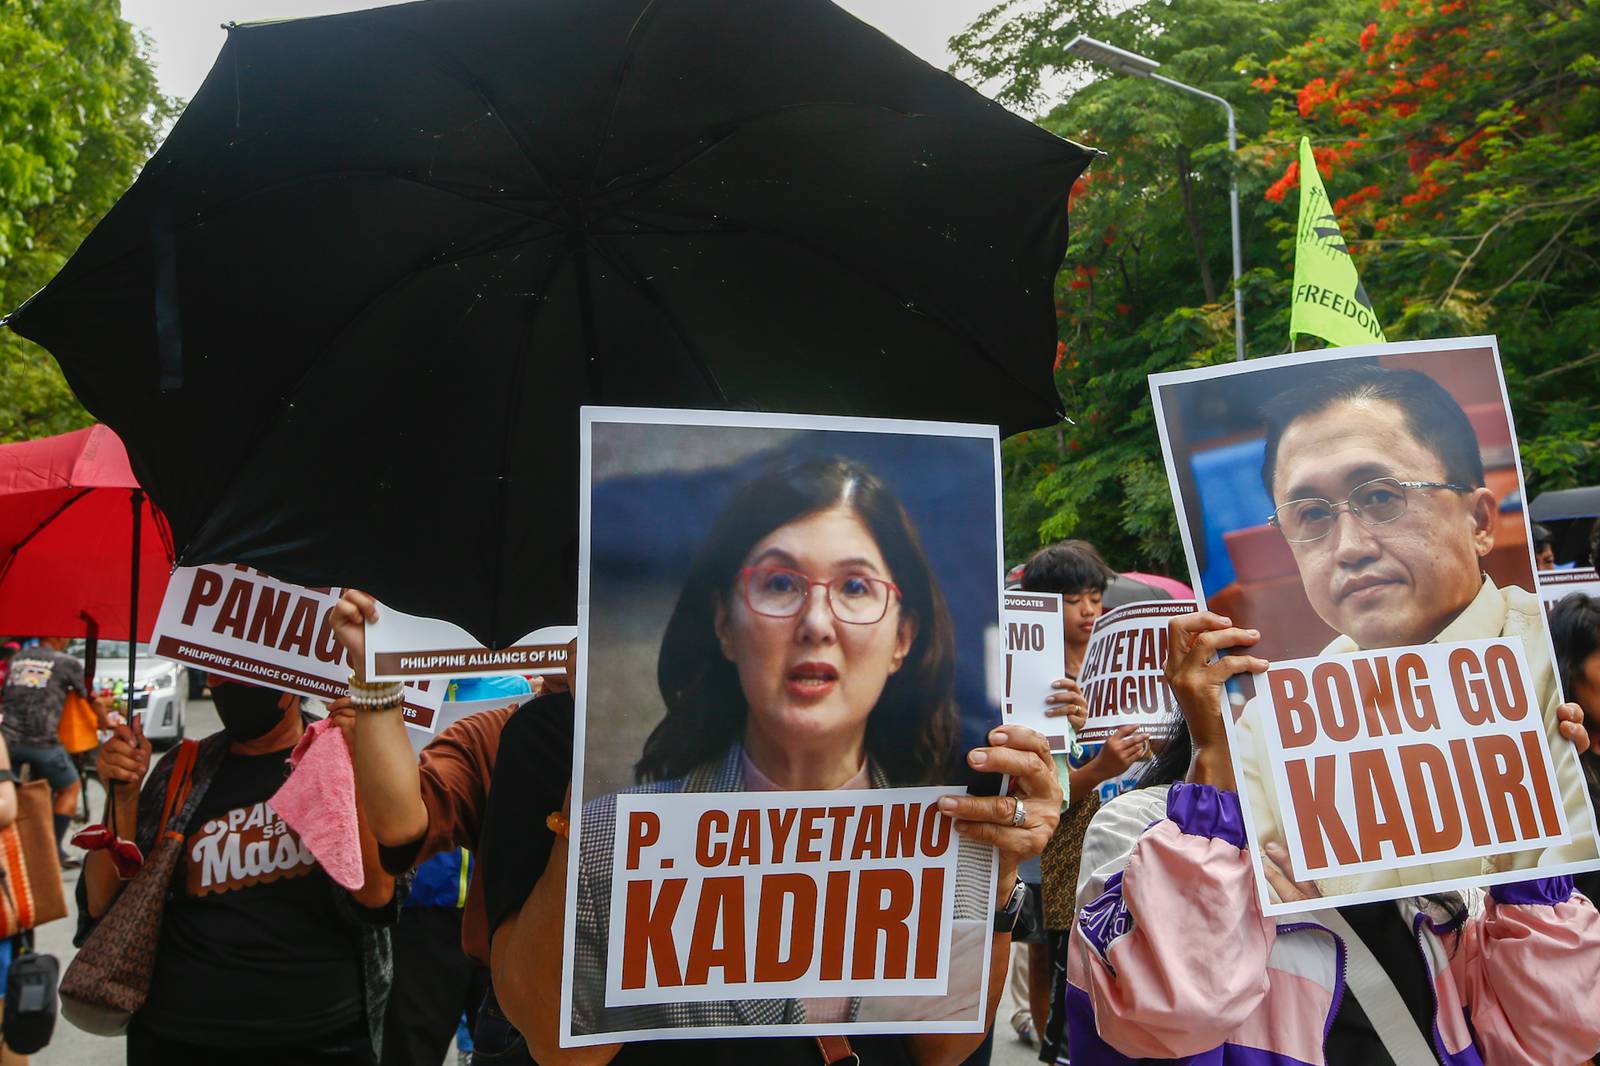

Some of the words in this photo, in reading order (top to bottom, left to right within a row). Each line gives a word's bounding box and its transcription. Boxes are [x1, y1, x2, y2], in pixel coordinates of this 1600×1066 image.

[181, 568, 354, 669] PANAG
[1005, 622, 1046, 652] MO
[178, 645, 232, 666] PHILIPPINE
[233, 660, 280, 679] ALLIANCE
[281, 672, 296, 683] OF
[295, 675, 333, 692] HUMAN
[334, 685, 352, 697] RIG
[400, 653, 466, 669] PHILIPPINE
[468, 651, 527, 667] ALLIANCE
[527, 650, 545, 663] OF
[548, 650, 568, 661] HU
[1267, 652, 1441, 749] BONG
[1448, 644, 1529, 726] GO
[263, 821, 287, 839] sa
[1284, 730, 1562, 870] KADIRI
[626, 811, 675, 870] P.
[695, 802, 954, 868] CAYETANO
[621, 867, 945, 990] KADIRI
